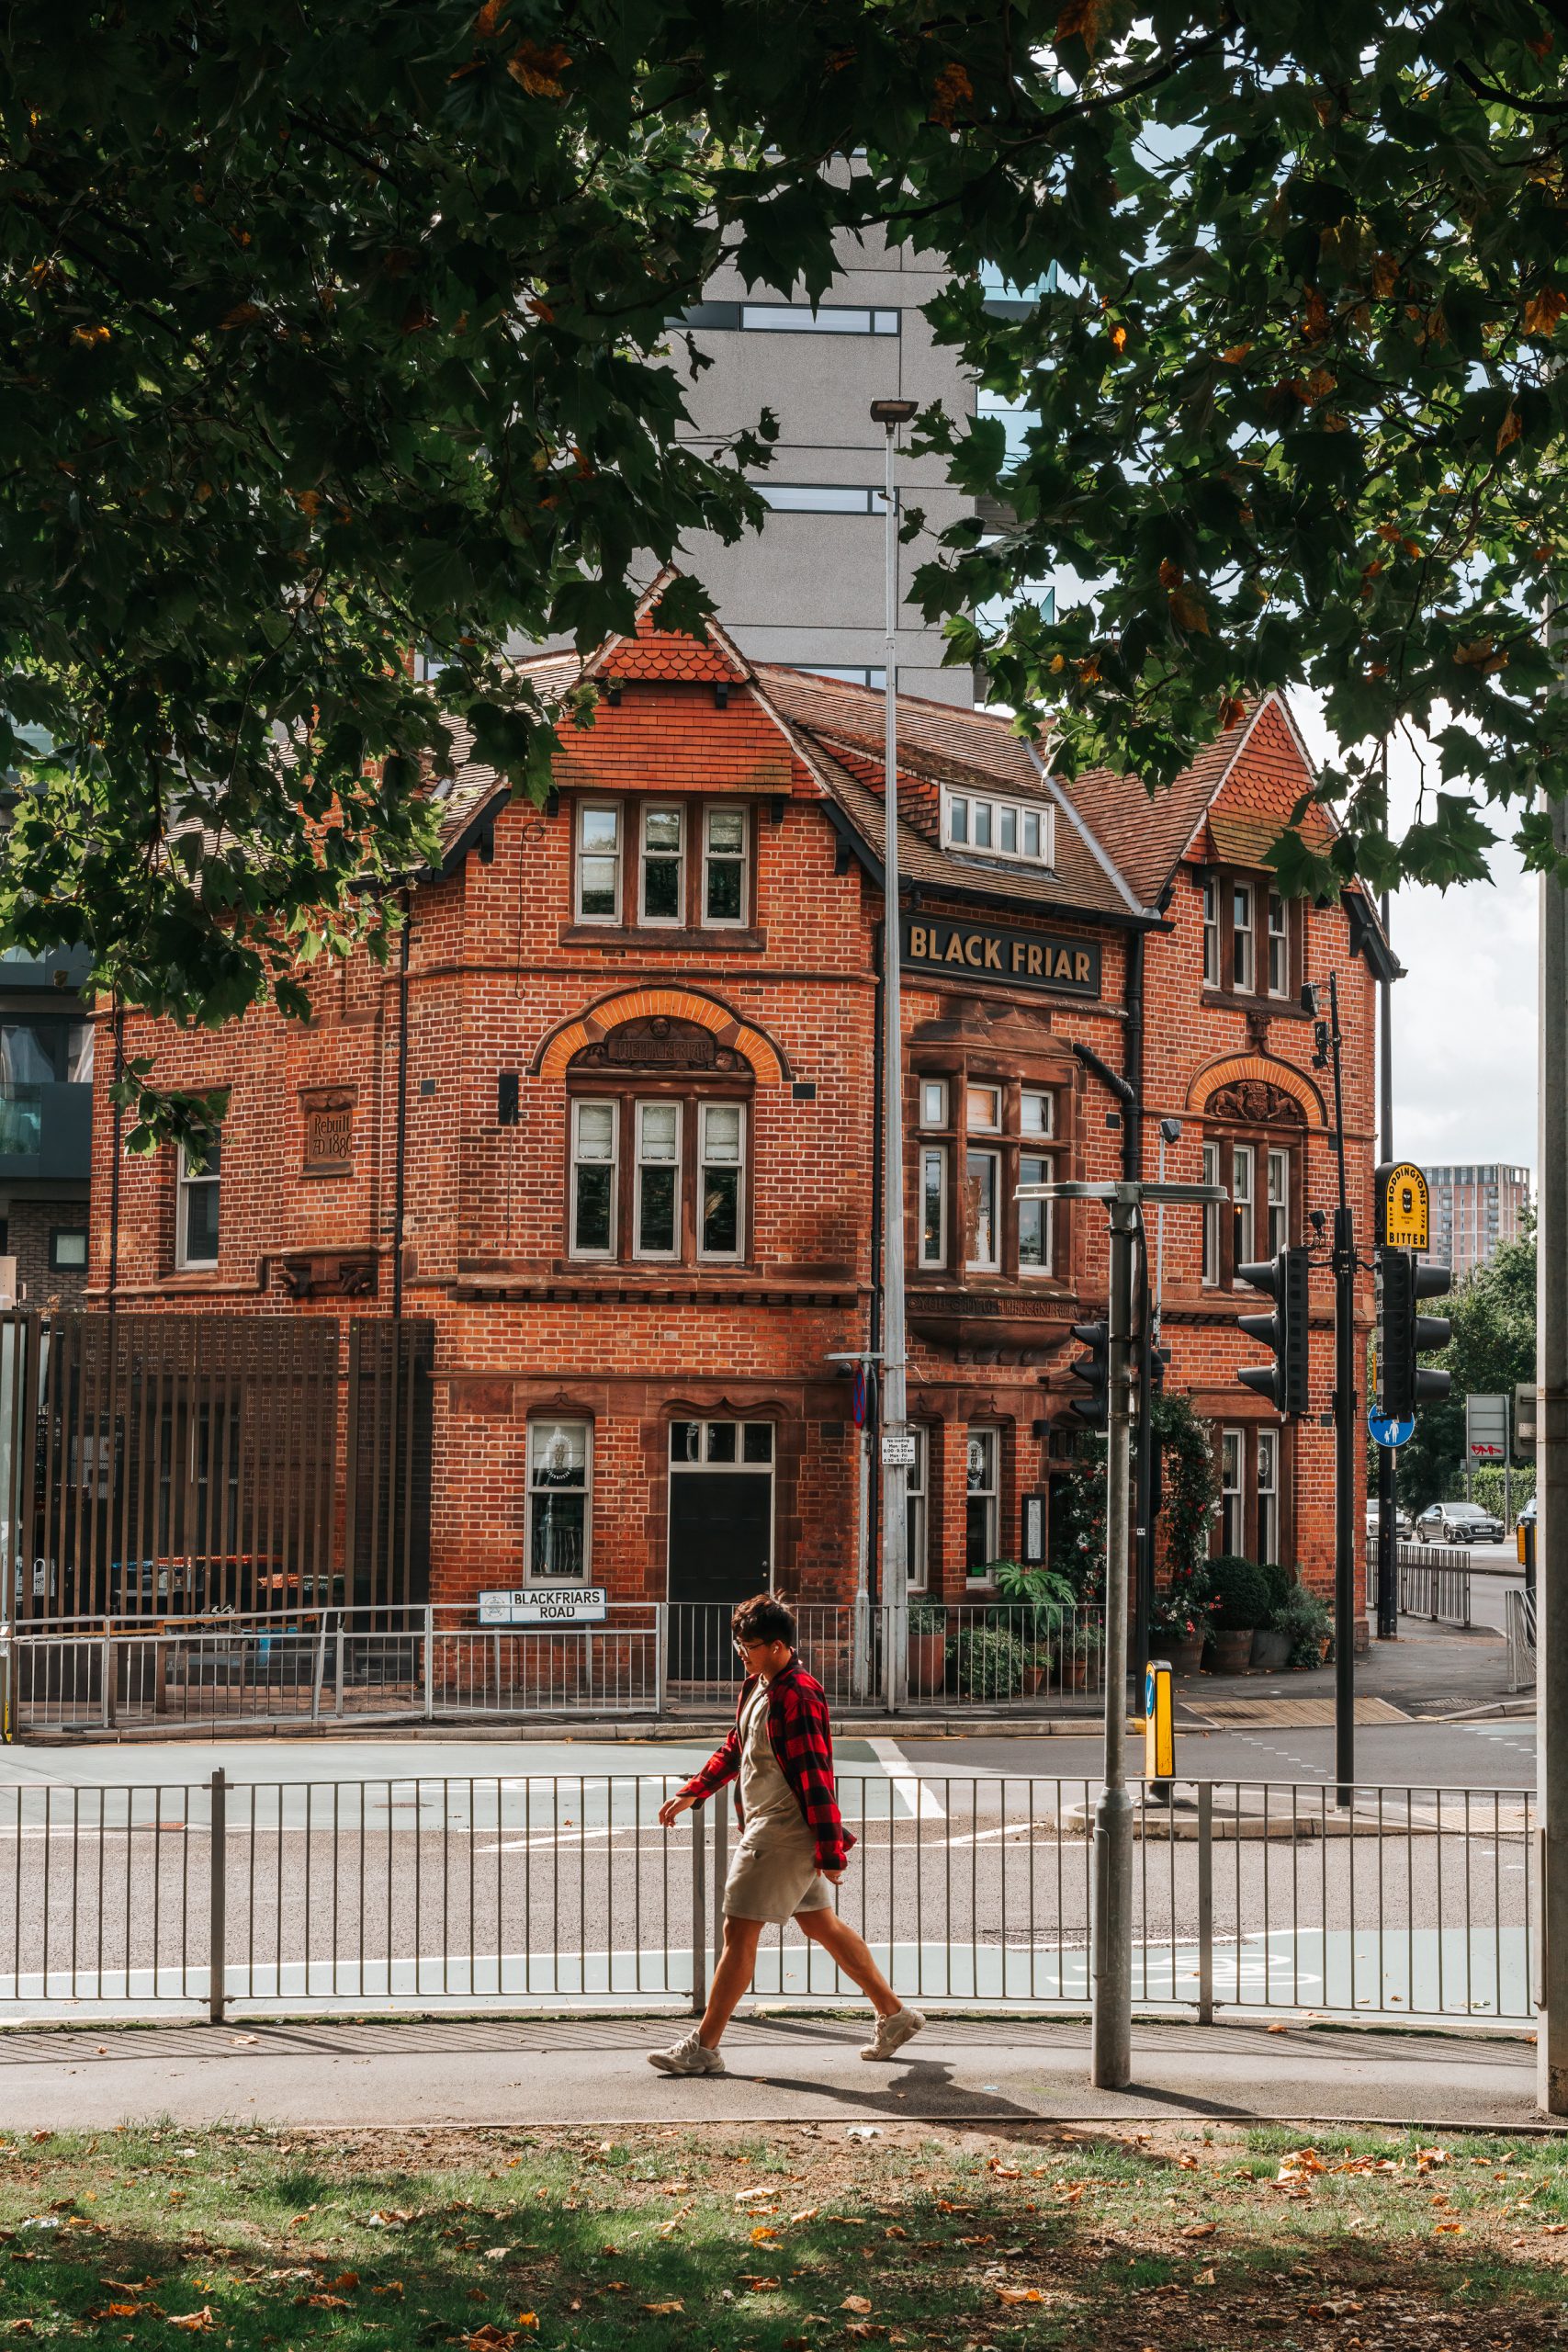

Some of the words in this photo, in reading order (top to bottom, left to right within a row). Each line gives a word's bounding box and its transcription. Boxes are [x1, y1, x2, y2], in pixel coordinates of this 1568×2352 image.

[910, 926, 1002, 969] BLACK
[1011, 942, 1090, 982] FRIAR
[314, 1114, 351, 1137] Rebuilt
[329, 1133, 353, 1158] 1886
[1388, 1167, 1426, 1205] BODDINGTONS
[1389, 1232, 1426, 1246] BITTER
[514, 1591, 600, 1605] BLACKFRIARS
[539, 1607, 575, 1618] ROAD
